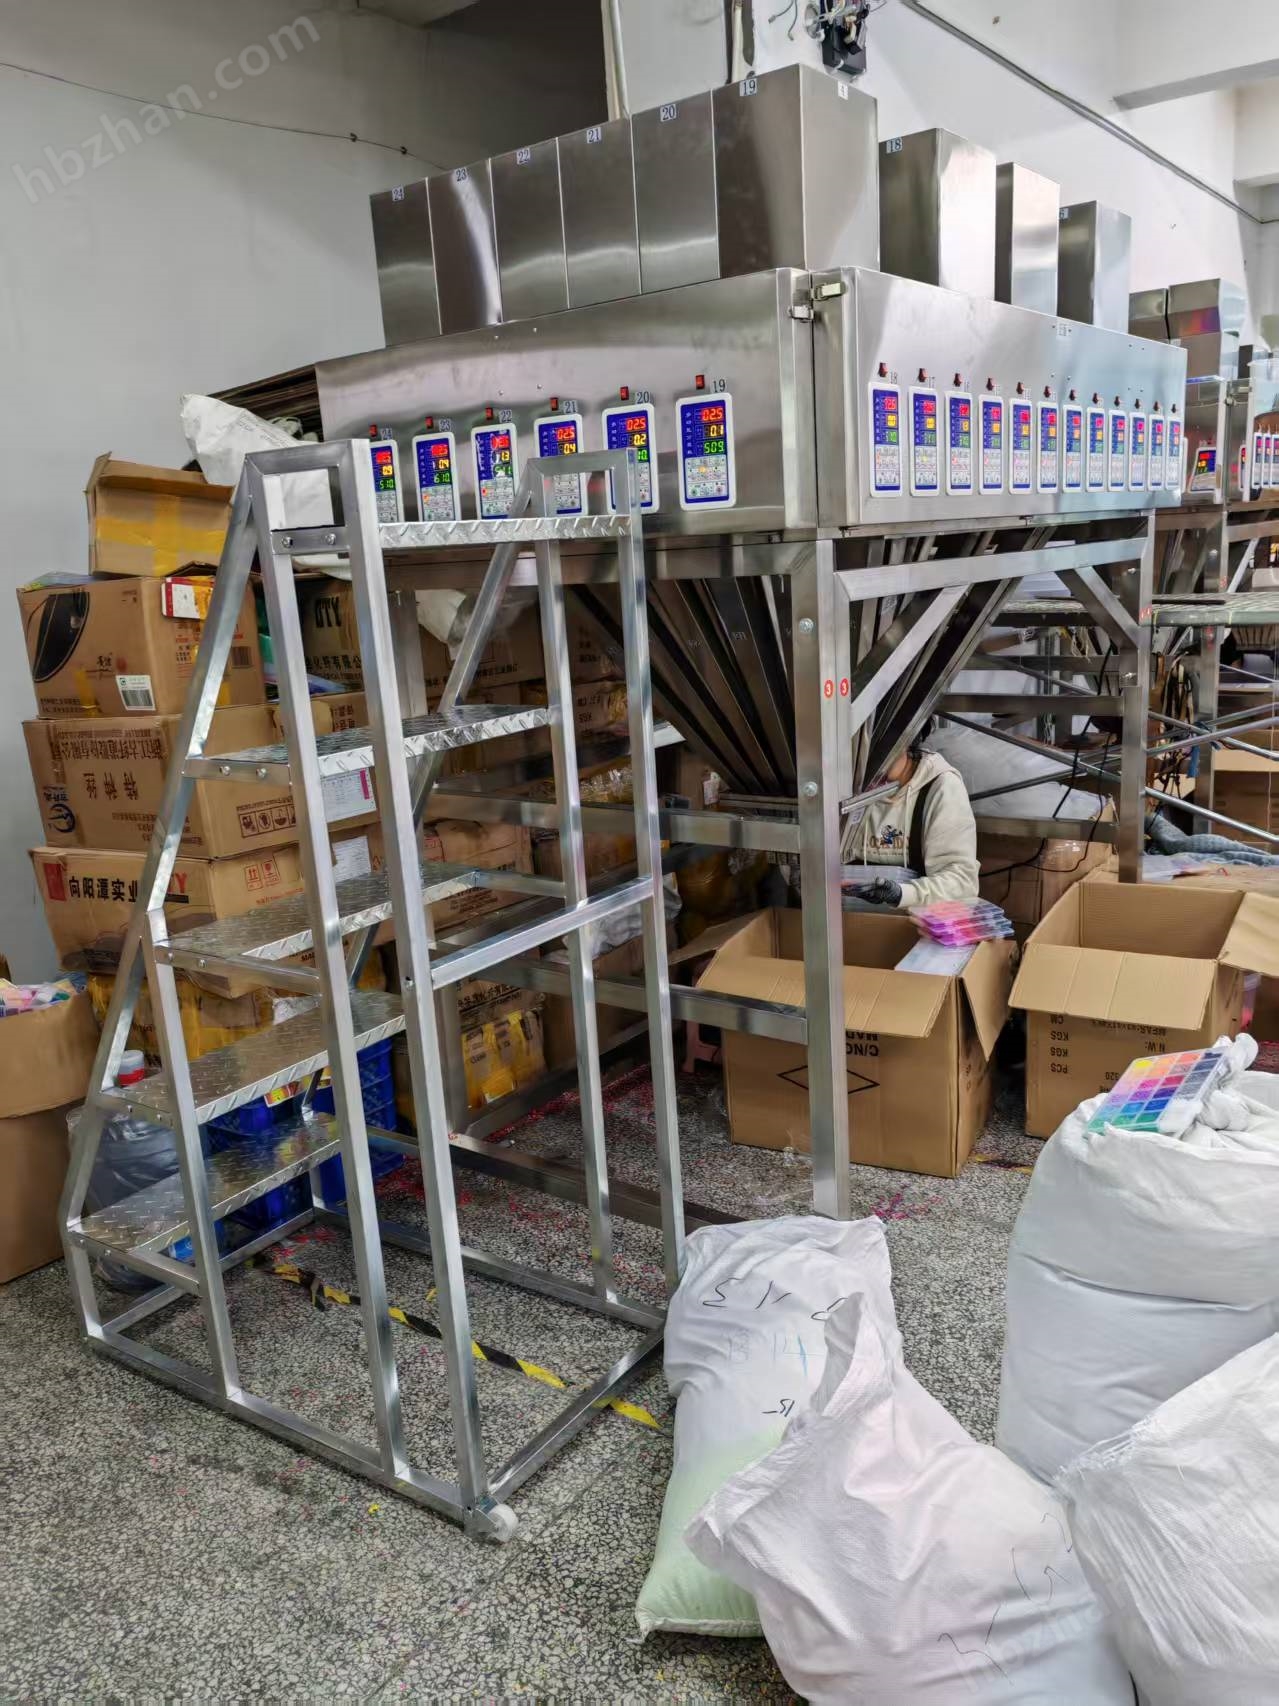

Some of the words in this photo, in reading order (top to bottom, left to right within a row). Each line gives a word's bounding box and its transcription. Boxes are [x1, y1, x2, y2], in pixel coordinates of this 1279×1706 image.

[743, 80, 755, 95] 19
[662, 105, 675, 120] 20
[588, 129, 600, 142] 21
[890, 138, 902, 152] 18
[518, 150, 530, 162] 22
[456, 169, 467, 181] 23
[713, 379, 726, 393] 19
[636, 391, 650, 404] 20
[565, 401, 577, 413] 21
[501, 410, 511, 422] 22
[704, 441, 724, 454] 509
[1050, 1030, 1069, 1041] KGS
[1050, 1047, 1068, 1057] KGS
[1050, 1062, 1068, 1074] PCS
